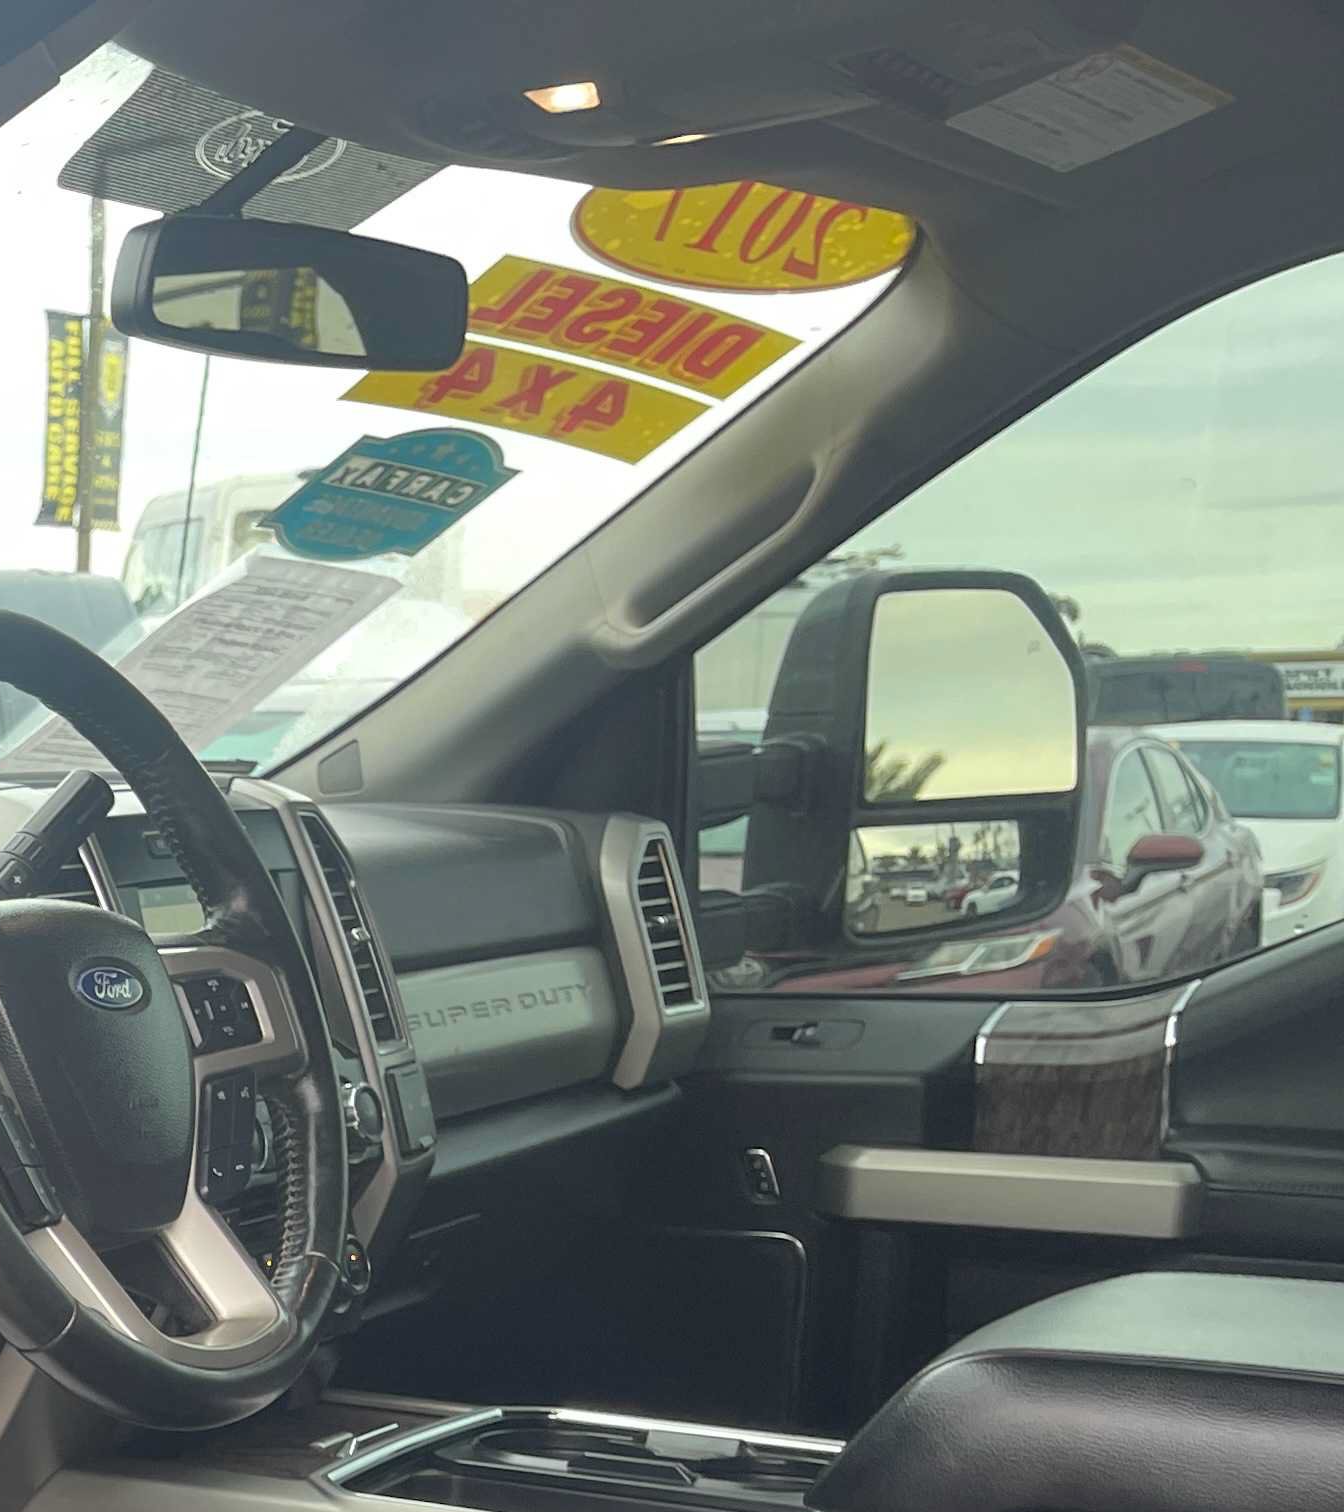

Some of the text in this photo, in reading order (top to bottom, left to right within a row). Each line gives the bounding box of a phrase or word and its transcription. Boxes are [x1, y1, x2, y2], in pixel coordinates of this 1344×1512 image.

[44, 338, 65, 501] AUTO CARE
[55, 320, 82, 522] FULL SERVICE
[93, 971, 132, 999] Ford
[407, 983, 590, 1032] SUPER DUTY
